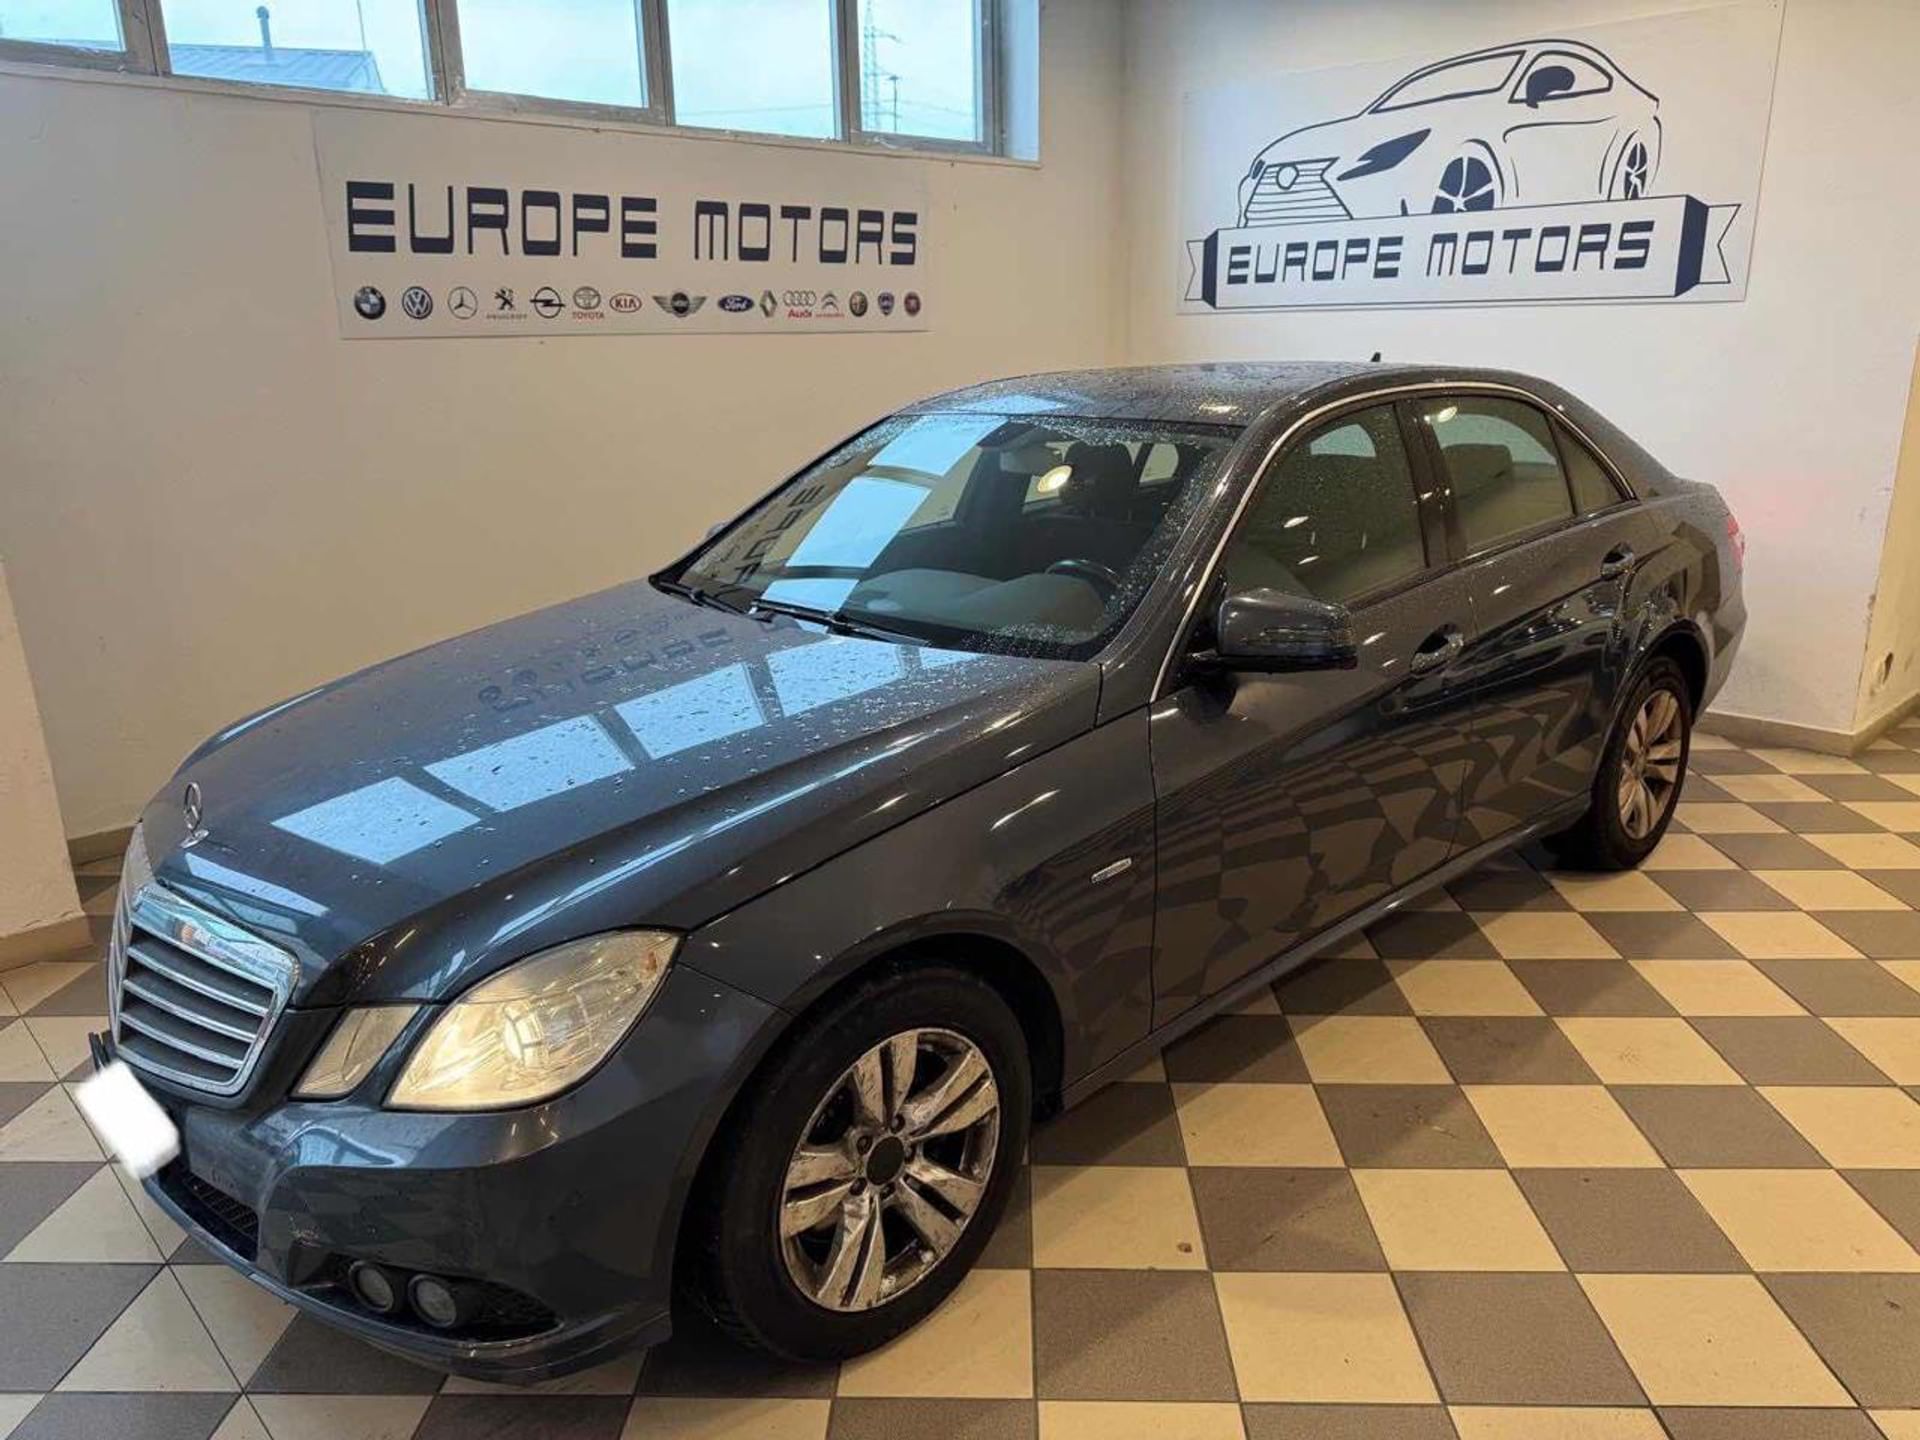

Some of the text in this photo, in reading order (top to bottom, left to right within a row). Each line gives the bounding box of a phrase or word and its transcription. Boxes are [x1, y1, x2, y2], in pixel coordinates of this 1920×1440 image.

[346, 181, 918, 266] EUROPE MOTORS
[1226, 220, 1656, 285] EUROPE MOTORS
[615, 297, 637, 309] KIA
[572, 311, 605, 319] TOYOTA
[788, 308, 813, 319] Audi
